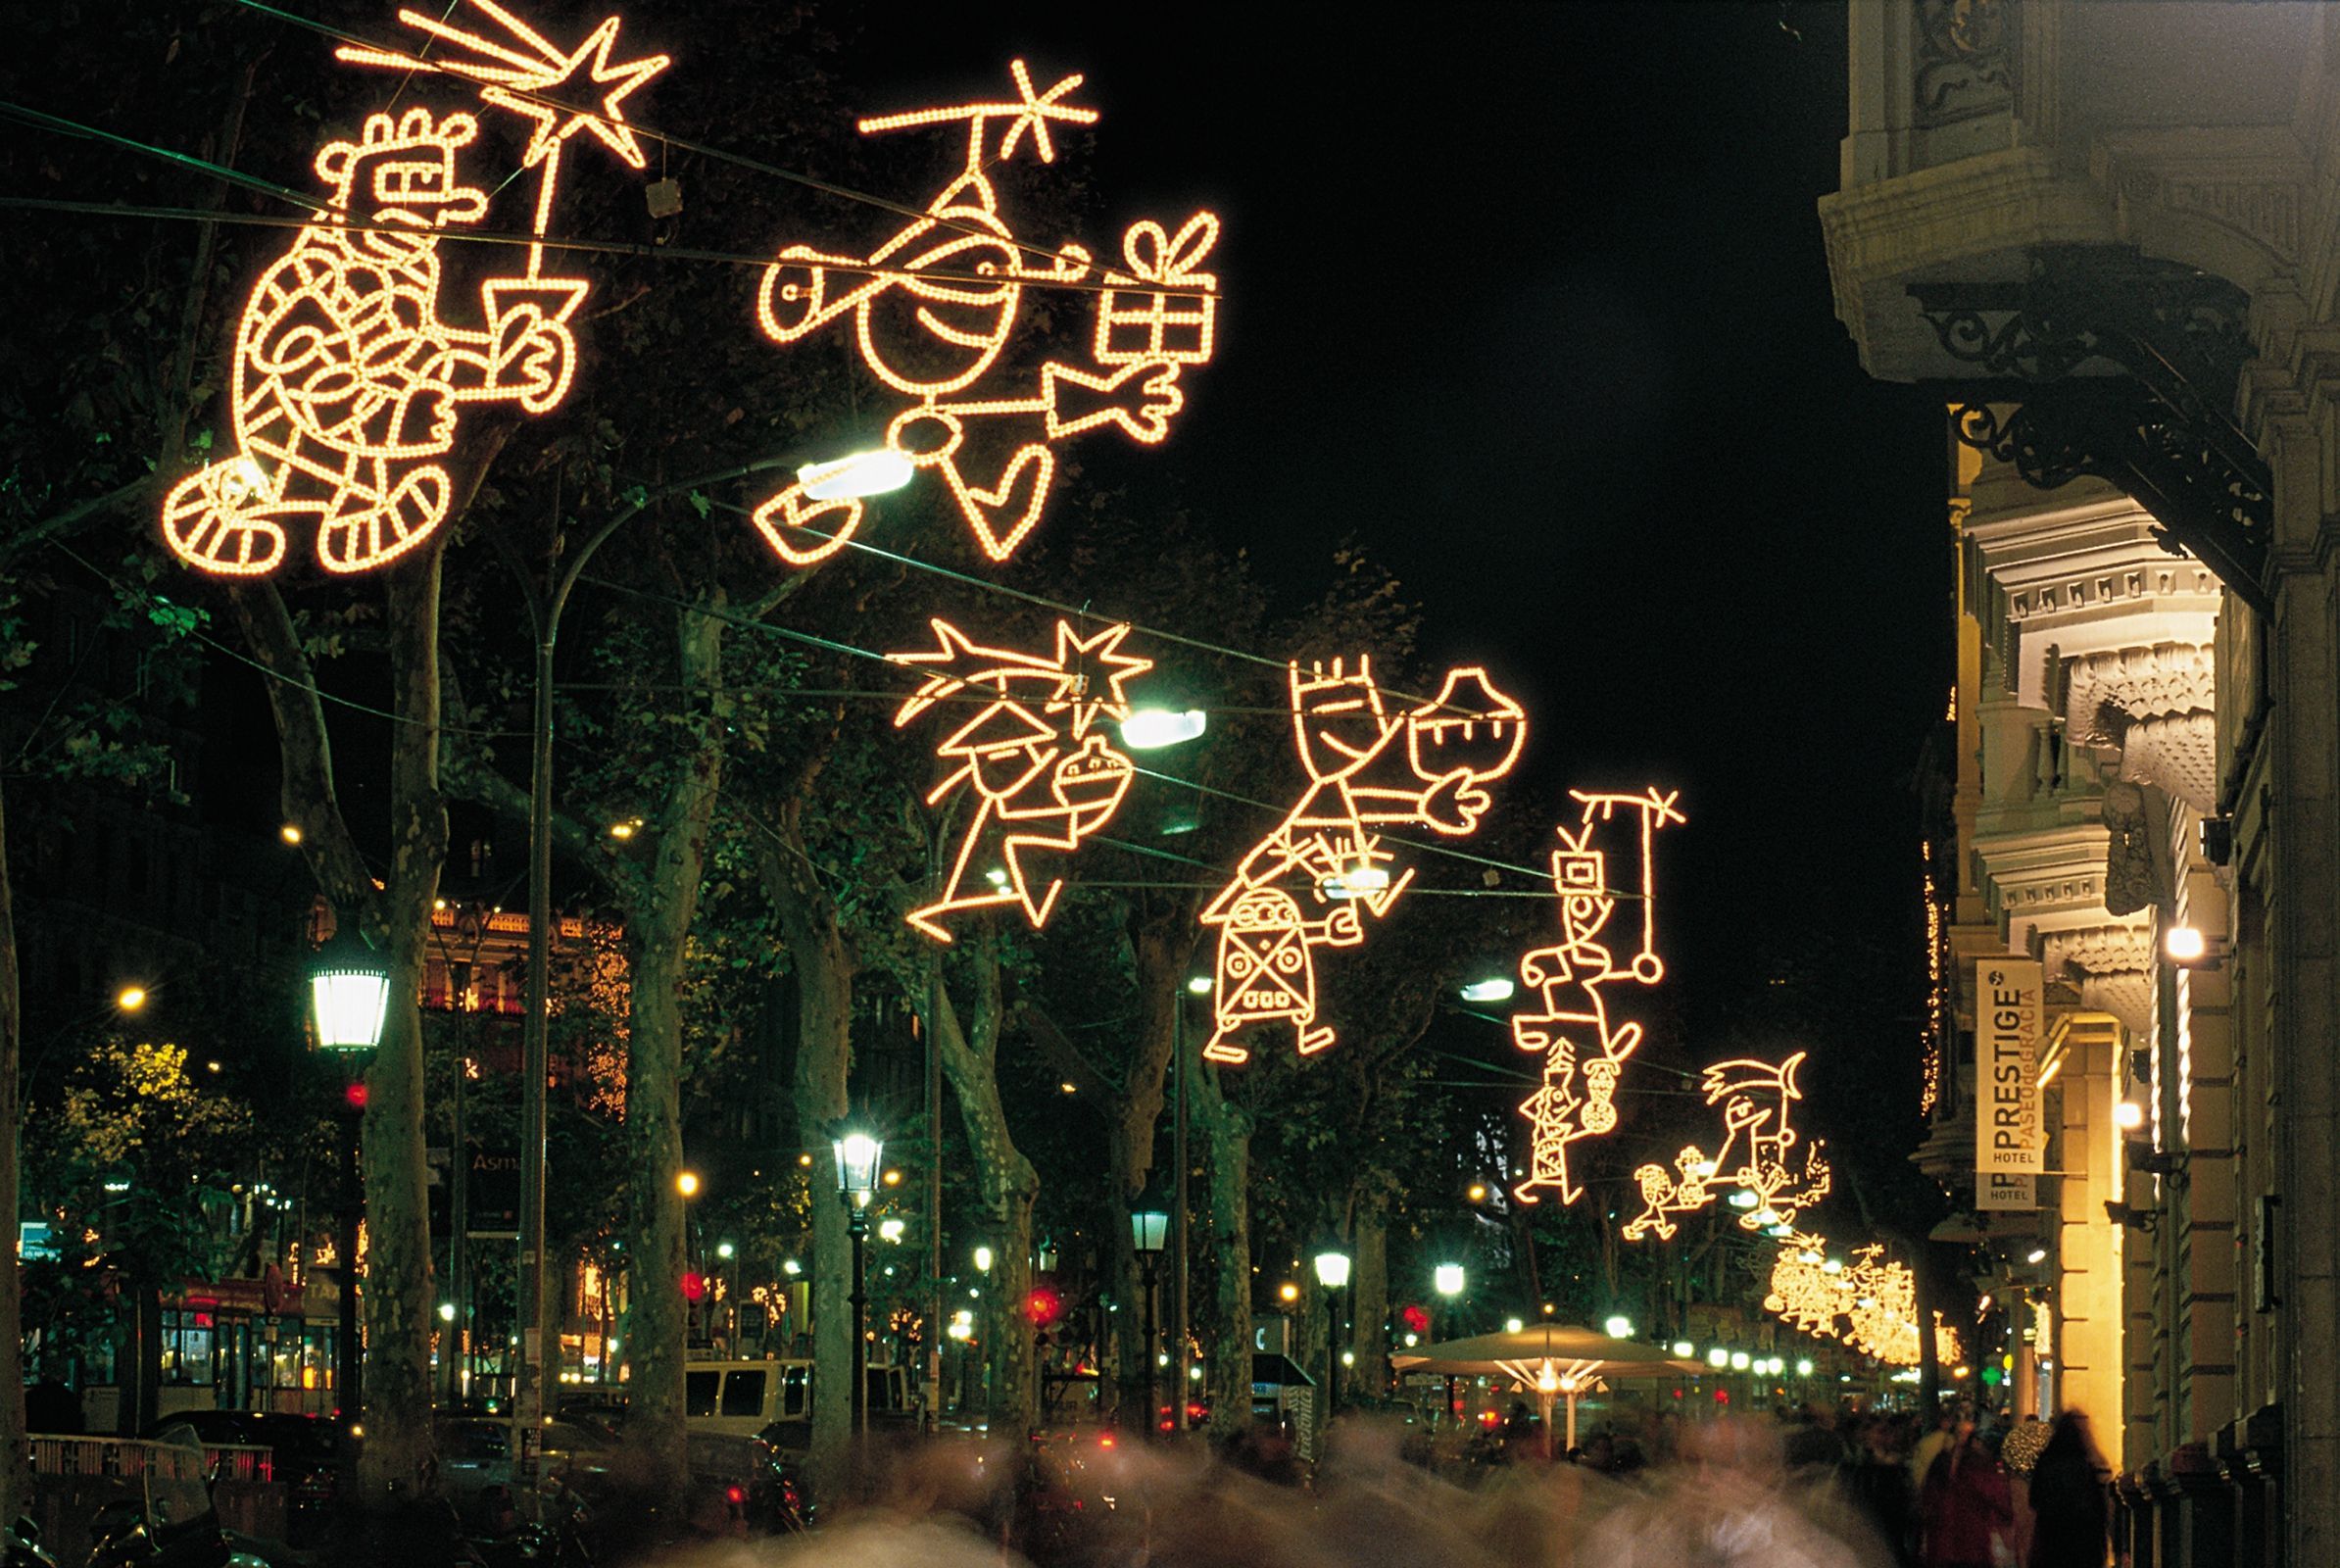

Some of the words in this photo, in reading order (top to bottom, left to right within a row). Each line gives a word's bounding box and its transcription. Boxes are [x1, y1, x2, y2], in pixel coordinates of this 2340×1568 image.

[1993, 989, 2021, 1150] PRESTIGE
[1993, 1152, 2035, 1164] HOTEL
[1990, 1190, 2028, 1200] HOTEL
